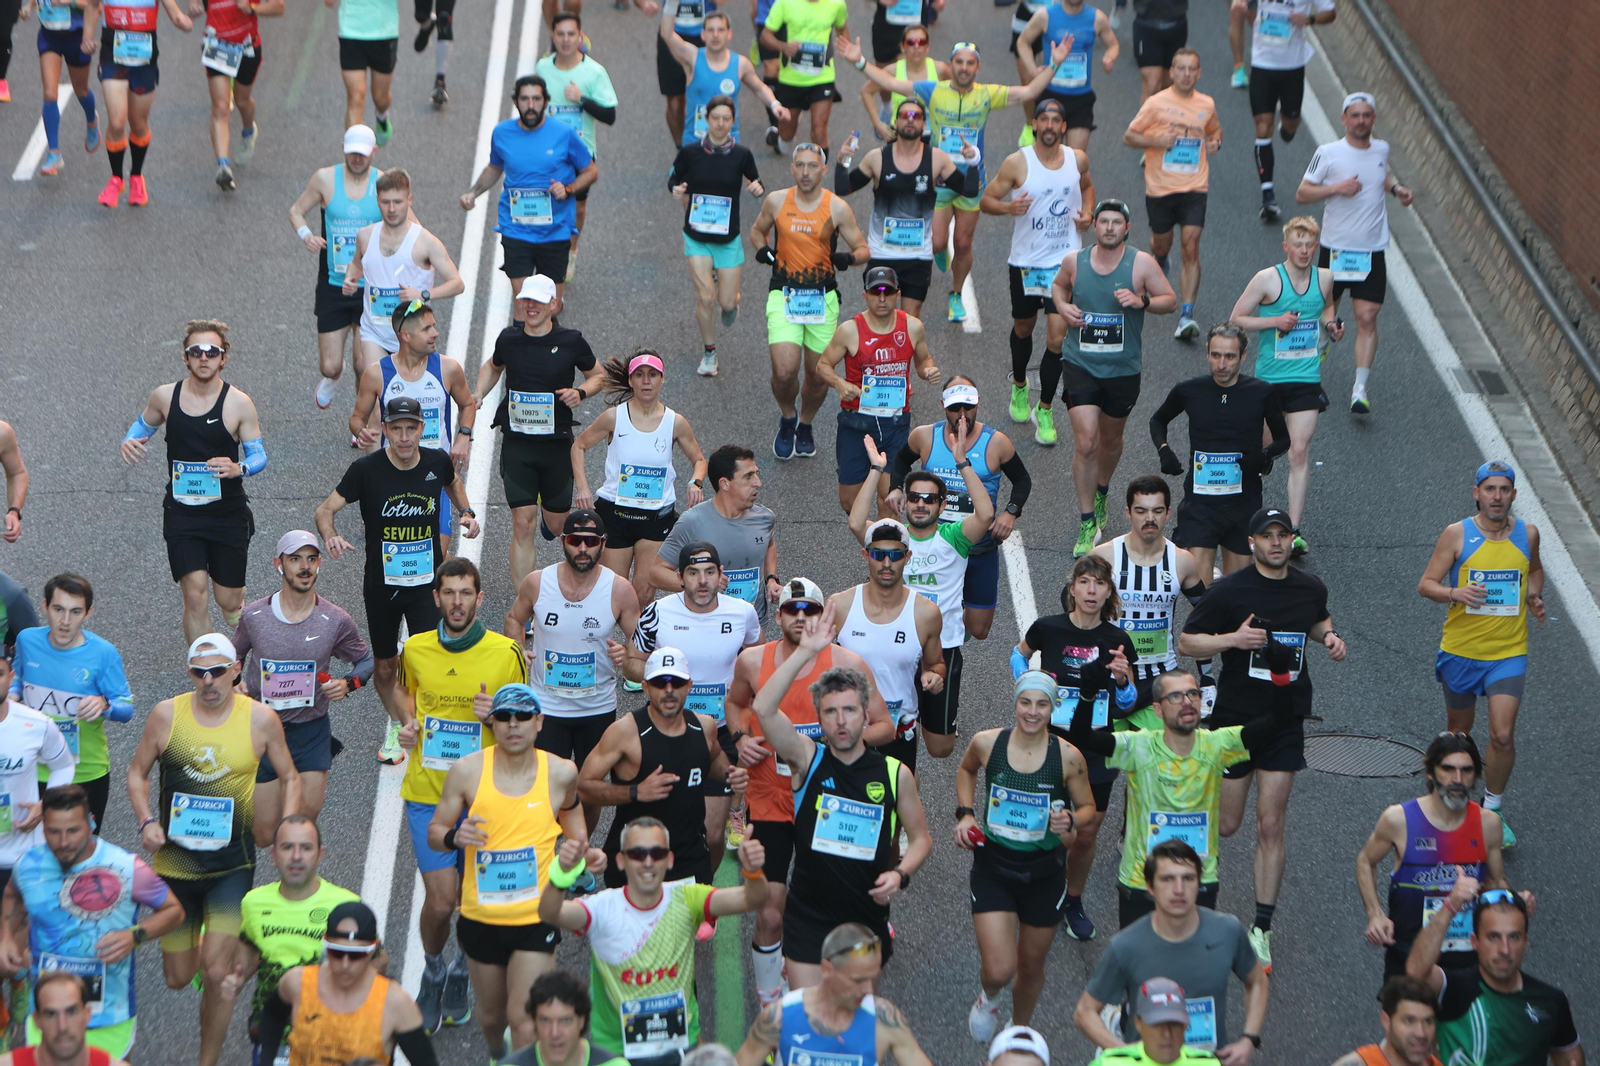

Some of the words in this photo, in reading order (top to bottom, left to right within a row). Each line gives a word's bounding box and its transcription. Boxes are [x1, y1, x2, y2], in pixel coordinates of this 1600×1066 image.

[705, 197, 727, 206] ZURICH
[1031, 217, 1044, 230] 16
[797, 289, 821, 297] ZURICH
[1094, 316, 1119, 324] ZURICH
[1093, 328, 1109, 337] 2479
[878, 378, 901, 387] ZURICH
[522, 394, 548, 403] ZURICH
[876, 392, 891, 400] 3511
[520, 409, 540, 417] 10975
[636, 468, 663, 476] ZURICH
[1209, 470, 1226, 478] 3666
[634, 482, 651, 490] 5038
[383, 525, 433, 541] SEVILLA
[400, 543, 427, 553] ZURICH
[400, 559, 418, 568] 3858
[402, 568, 418, 576] ALON
[728, 573, 755, 582] ZURICH
[1491, 573, 1515, 581] ZURICH
[726, 587, 743, 596] 5461
[1137, 621, 1165, 630] ZURICH
[1137, 637, 1154, 646] 1946
[560, 655, 590, 665] ZURICH
[278, 664, 308, 673] ZURICH
[560, 671, 578, 679] 4057
[278, 680, 295, 689] 7277
[689, 686, 720, 695] ZURICH
[688, 702, 707, 711] 5965
[442, 723, 474, 734] ZURICH
[442, 739, 460, 749] 3598
[441, 751, 461, 759] DARIO
[1010, 793, 1043, 805] ZURICH
[192, 799, 225, 810] ZURICH
[842, 803, 875, 818] ZURICH
[1008, 809, 1028, 819] 4643
[1169, 815, 1202, 825] ZURICH
[838, 821, 858, 832] 5107
[1005, 820, 1029, 830] NAIADE
[837, 833, 855, 843] DAVE
[495, 851, 529, 863] ZURICH
[497, 871, 517, 881] 4608
[499, 883, 517, 891] GLEN
[643, 995, 679, 1011] ZURICH
